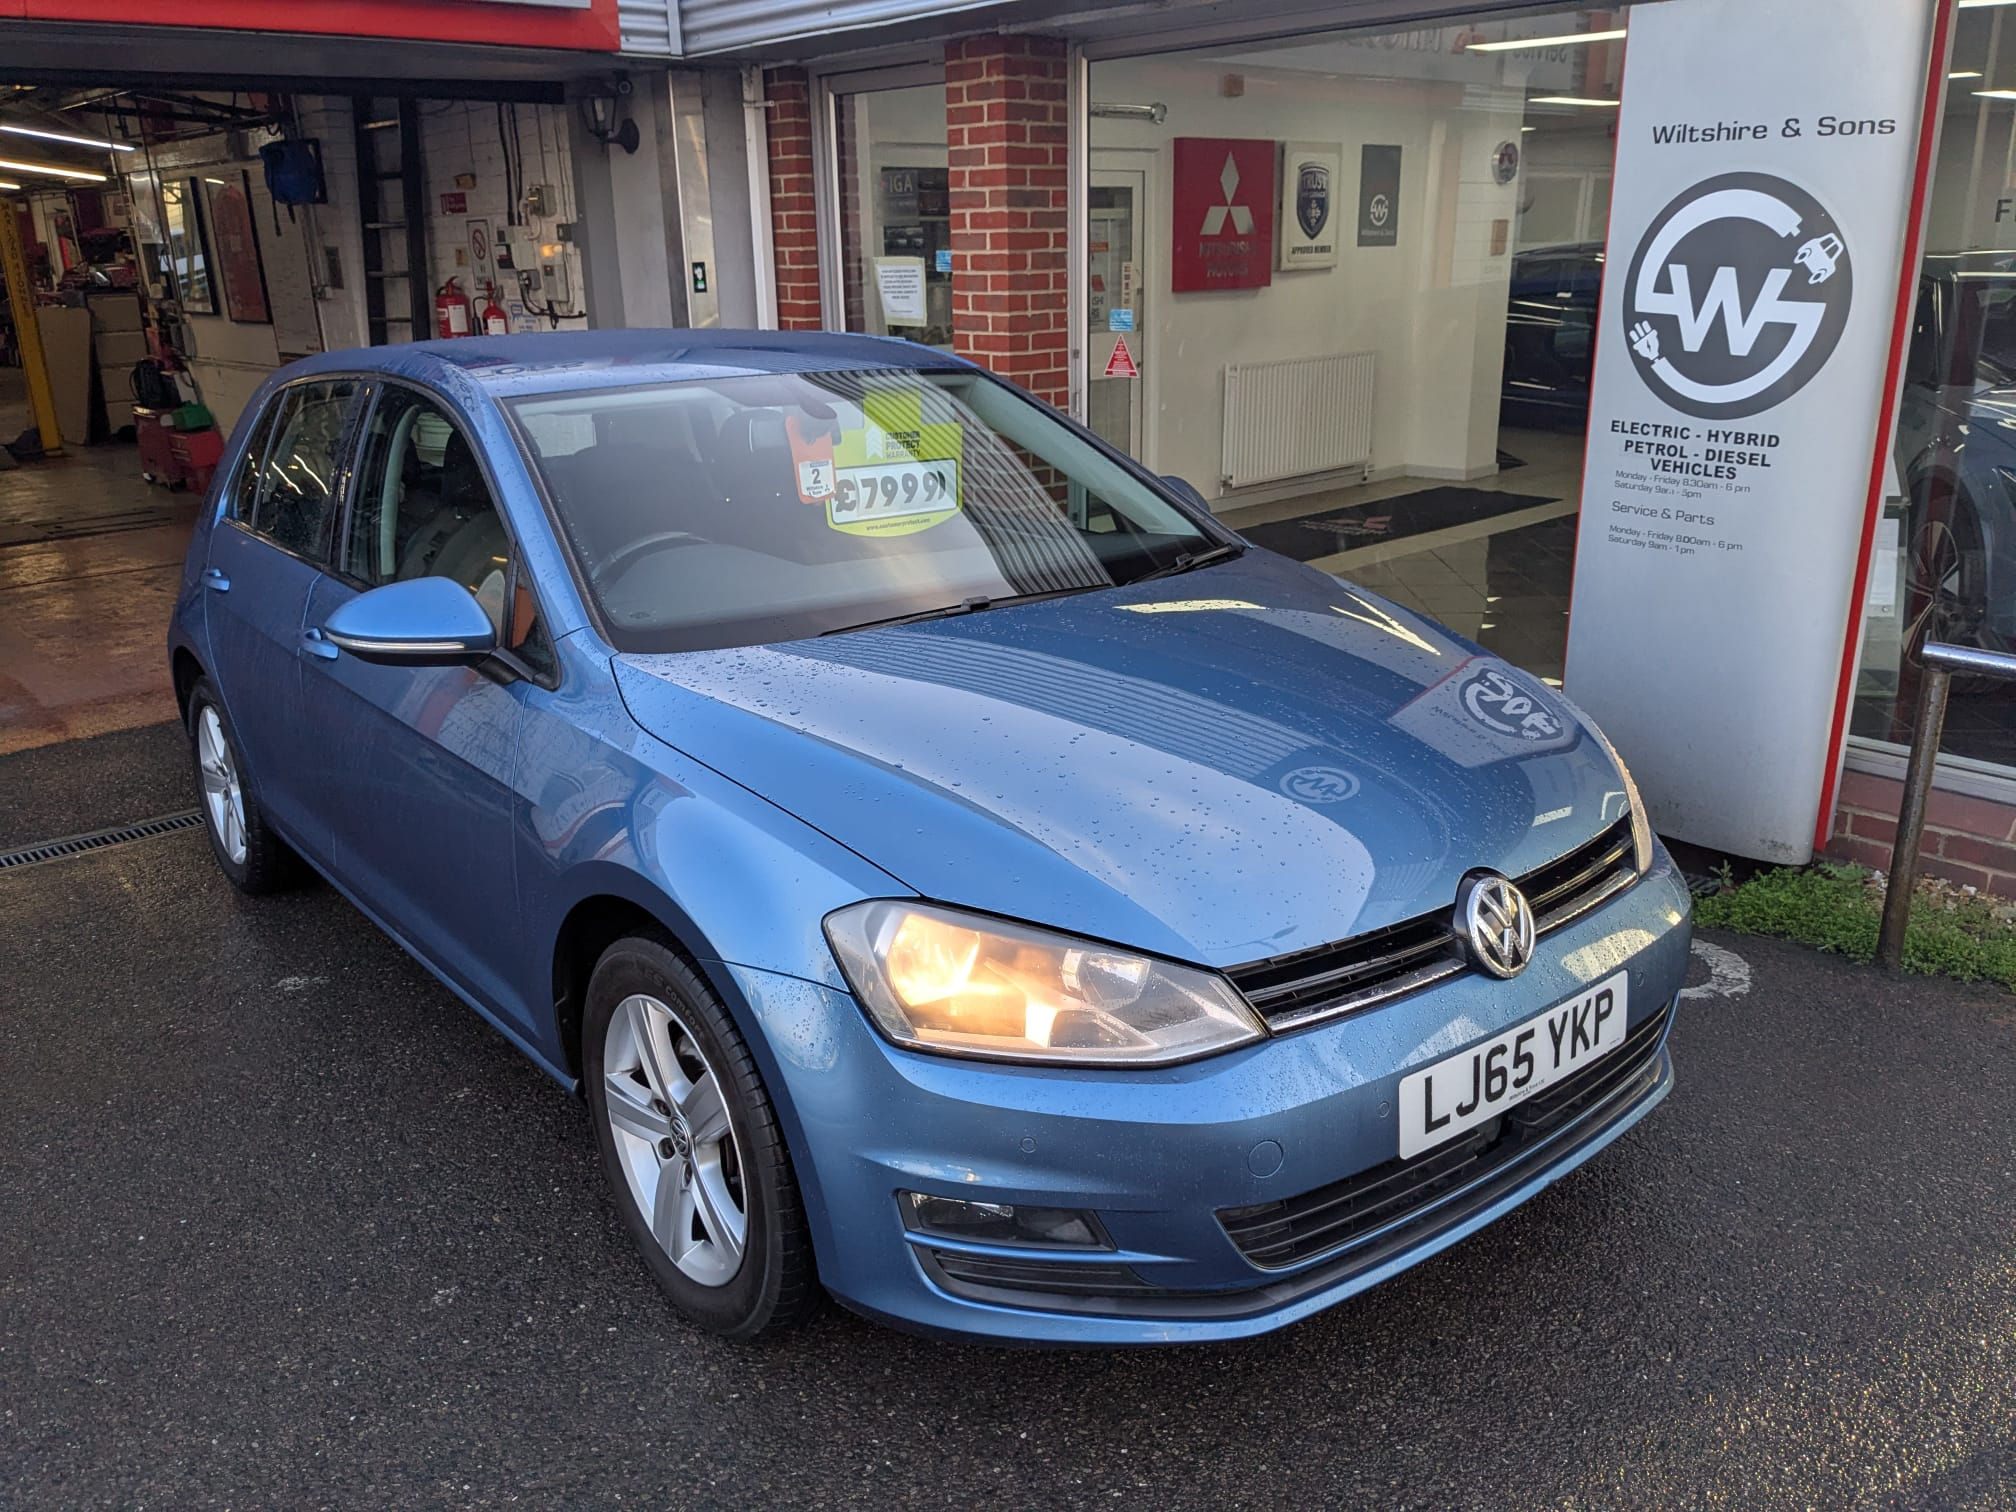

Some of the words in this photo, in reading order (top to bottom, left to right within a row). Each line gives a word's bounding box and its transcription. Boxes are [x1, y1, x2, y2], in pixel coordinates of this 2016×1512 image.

[1652, 121, 1768, 144] Wiltshire
[1781, 118, 1802, 138] &
[1817, 116, 1896, 136] Sons
[1611, 420, 1691, 440] ELECTRIC
[1707, 429, 1780, 448] HYBRID
[886, 439, 920, 450] PROTECT
[1624, 440, 1688, 459] PETROL
[1705, 449, 1771, 467] DIESEL
[811, 468, 822, 485] 2
[1615, 470, 1647, 482] Monday
[1654, 474, 1681, 487] Friday
[1651, 458, 1737, 480] VEHICLES
[1615, 480, 1653, 494] Saturday
[1612, 501, 1658, 518] Service
[1661, 508, 1672, 519] &
[1676, 510, 1715, 526] Parts
[1608, 535, 1646, 549] Saturday
[1648, 540, 1668, 551] 9am
[1609, 525, 1640, 538] Monday
[1648, 531, 1673, 543] Friday
[1424, 1028, 1536, 1135] LJ65
[1548, 988, 1613, 1069] YKP
